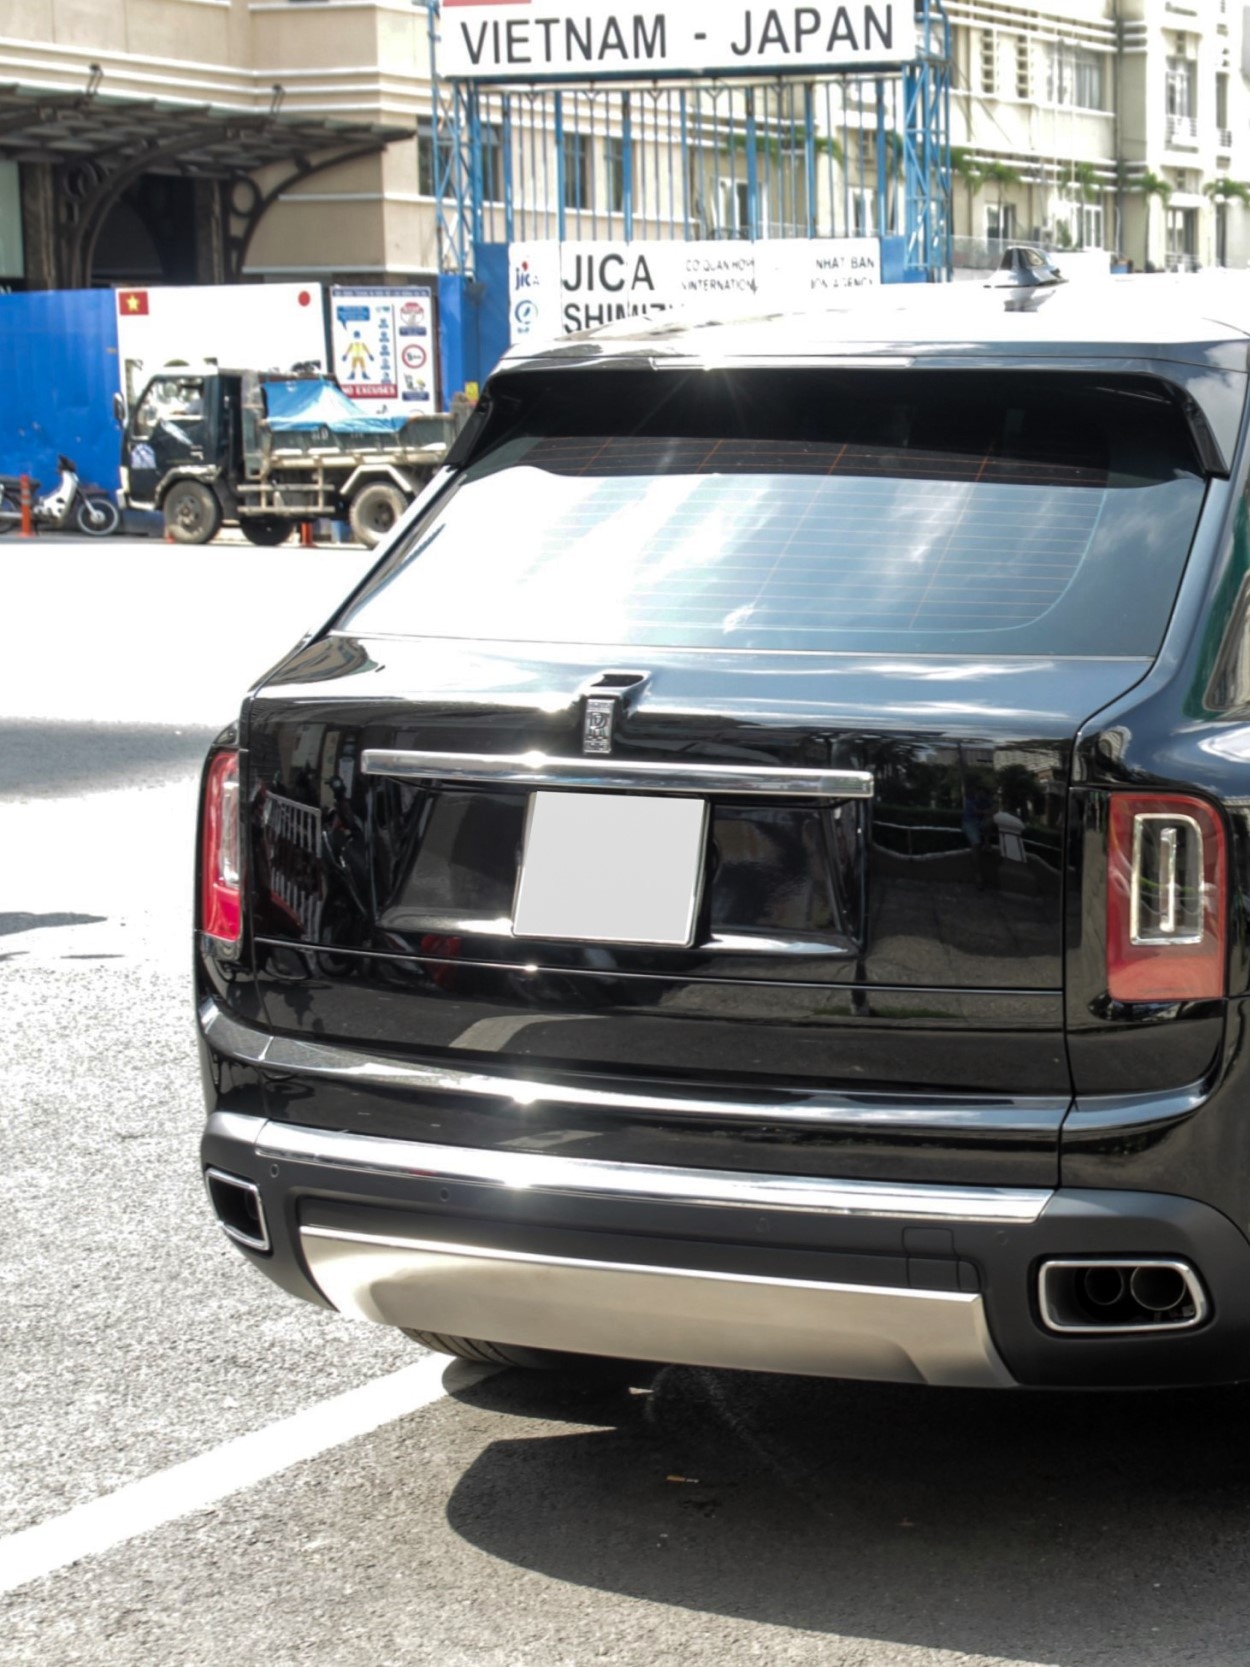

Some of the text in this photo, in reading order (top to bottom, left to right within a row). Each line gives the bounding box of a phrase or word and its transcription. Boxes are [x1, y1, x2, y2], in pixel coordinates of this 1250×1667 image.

[460, 14, 667, 65] VIETNAM
[730, 4, 893, 56] JAPAN
[562, 253, 656, 292] JICA
